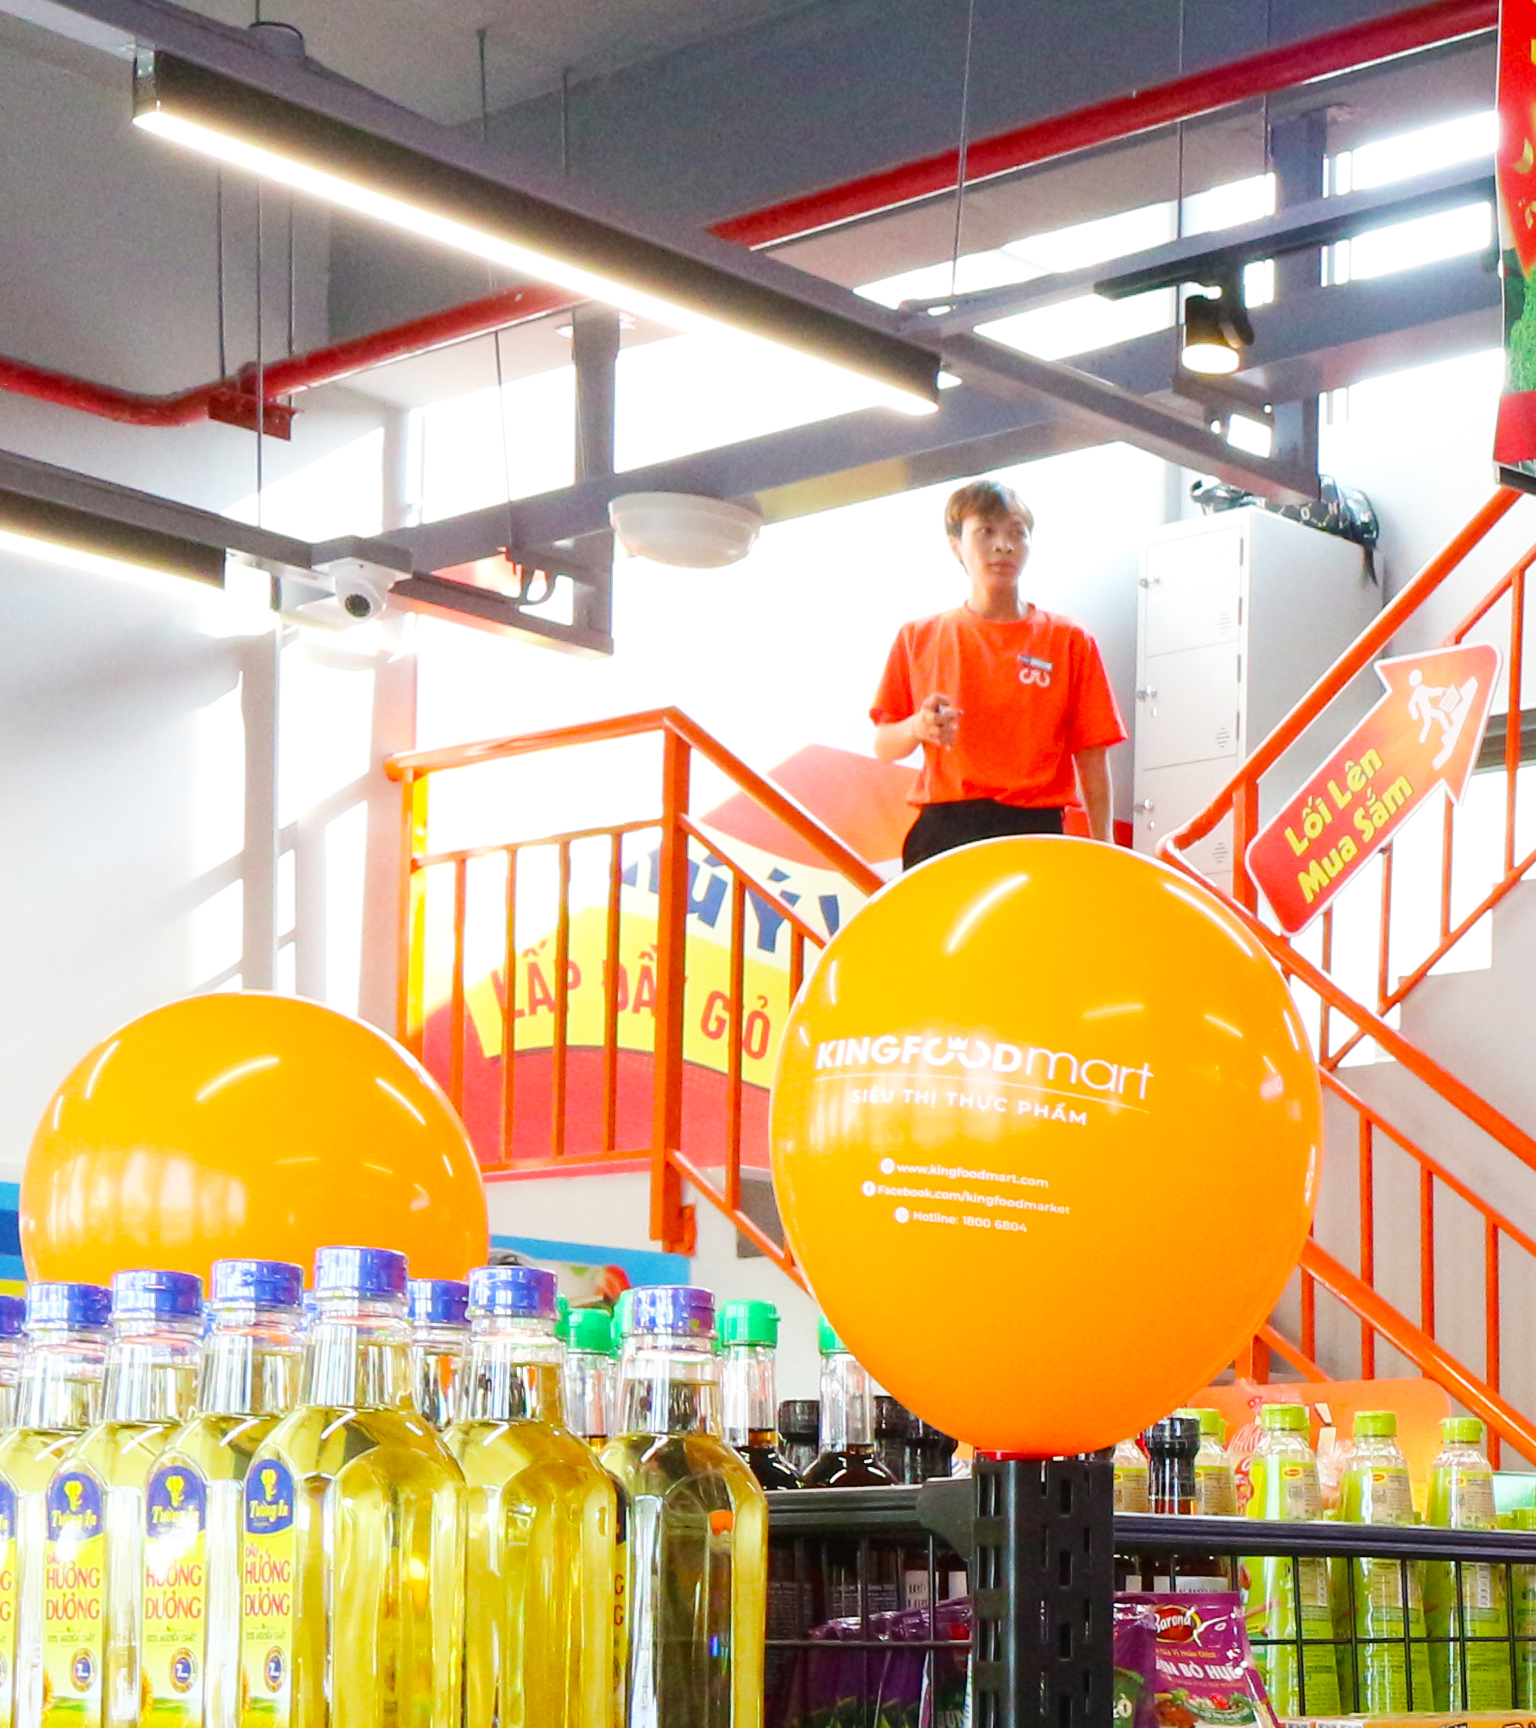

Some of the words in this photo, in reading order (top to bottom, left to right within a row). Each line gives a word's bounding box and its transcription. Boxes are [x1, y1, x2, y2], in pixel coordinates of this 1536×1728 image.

[1284, 795, 1334, 856] Lối
[1327, 748, 1384, 811] Lên
[1297, 835, 1359, 904] Mua
[1353, 776, 1415, 843] Sắm
[903, 1089, 937, 1109] THỊ
[946, 1091, 1008, 1113] THỰC
[1017, 1100, 1088, 1126] PHẨM
[897, 1163, 1049, 1189] www.kingfoodmart.com
[962, 1215, 991, 1229] 1800
[994, 1218, 1028, 1233] 6804
